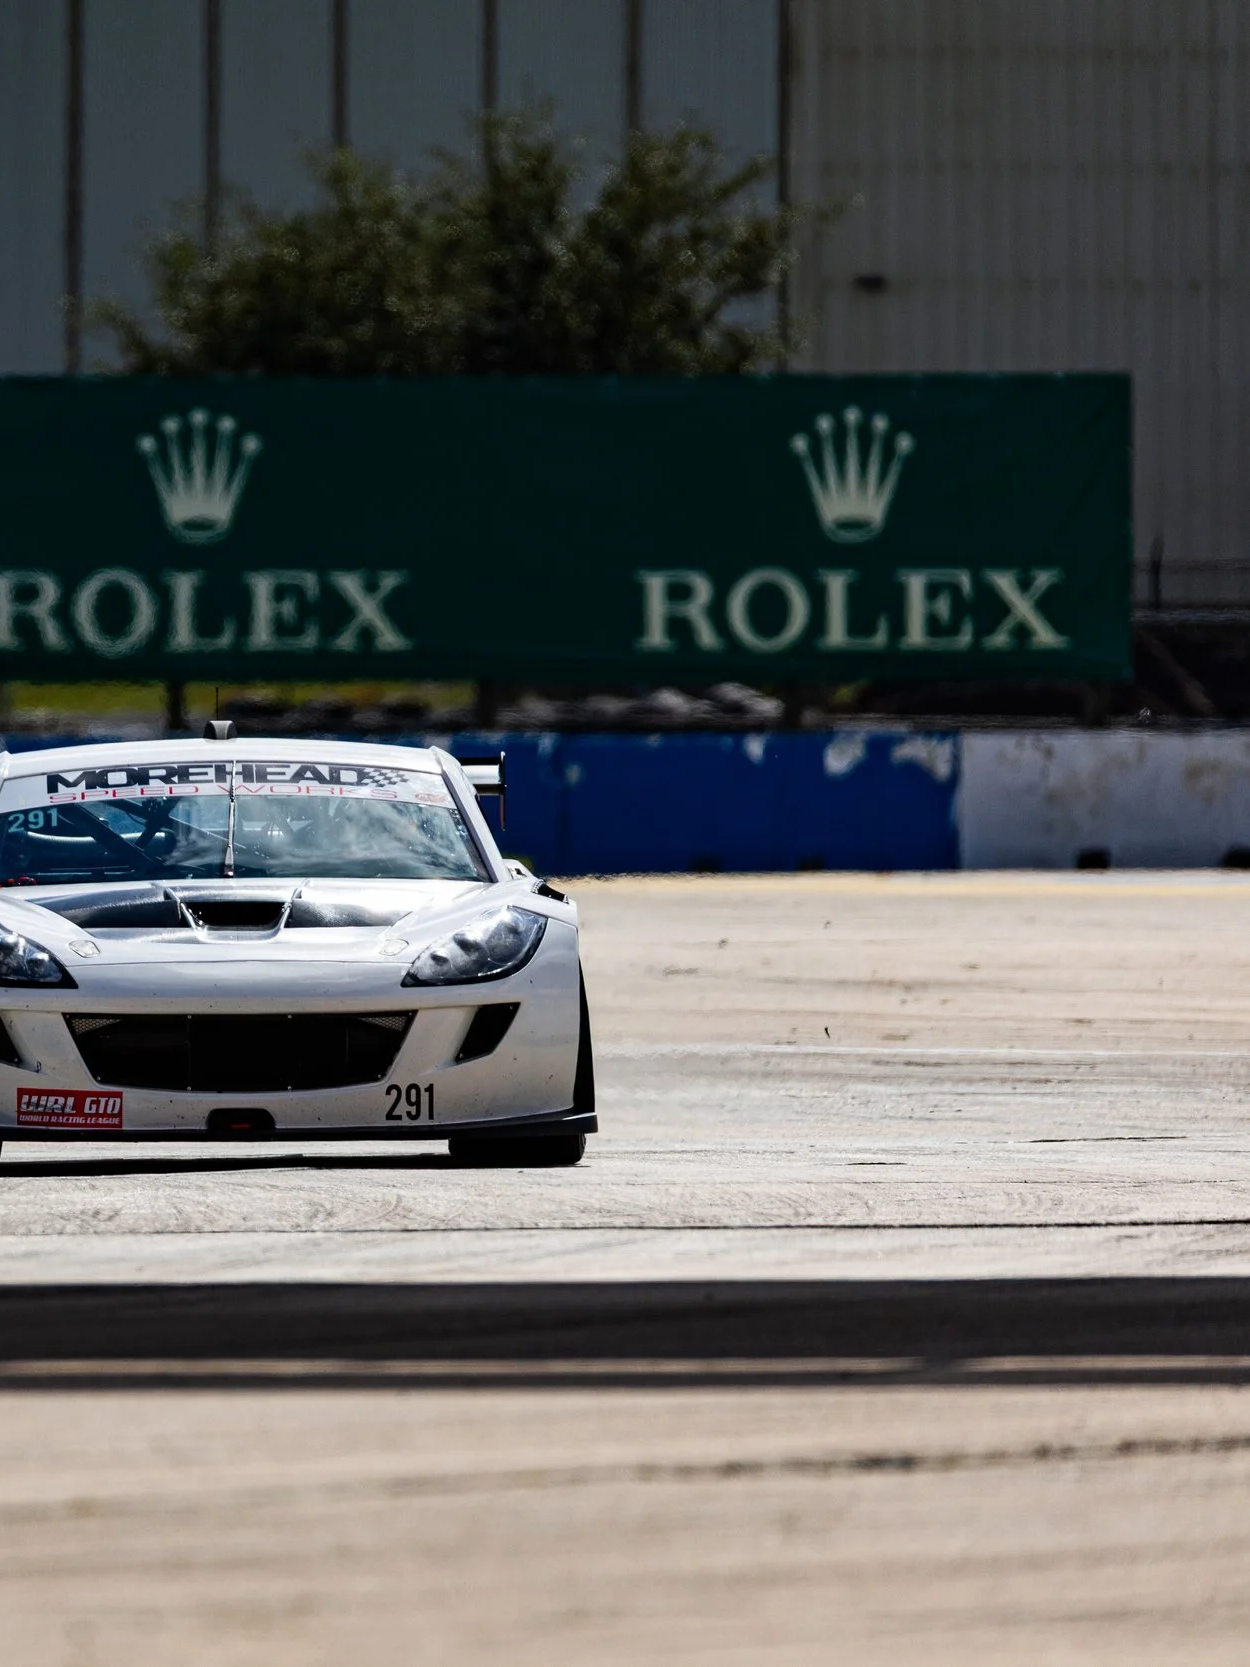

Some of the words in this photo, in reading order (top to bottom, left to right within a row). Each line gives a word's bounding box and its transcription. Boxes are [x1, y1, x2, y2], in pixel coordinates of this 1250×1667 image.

[635, 566, 1068, 653] ROLEX
[46, 763, 368, 794] MOREHEAD
[49, 785, 200, 804] SPEED
[216, 784, 398, 799] WORKS
[8, 807, 59, 833] 291
[20, 1094, 76, 1114] WRL
[385, 1083, 435, 1121] 291
[19, 1114, 50, 1123] WORLD
[50, 1115, 86, 1124] RACING
[86, 1116, 121, 1125] LEAGUE
